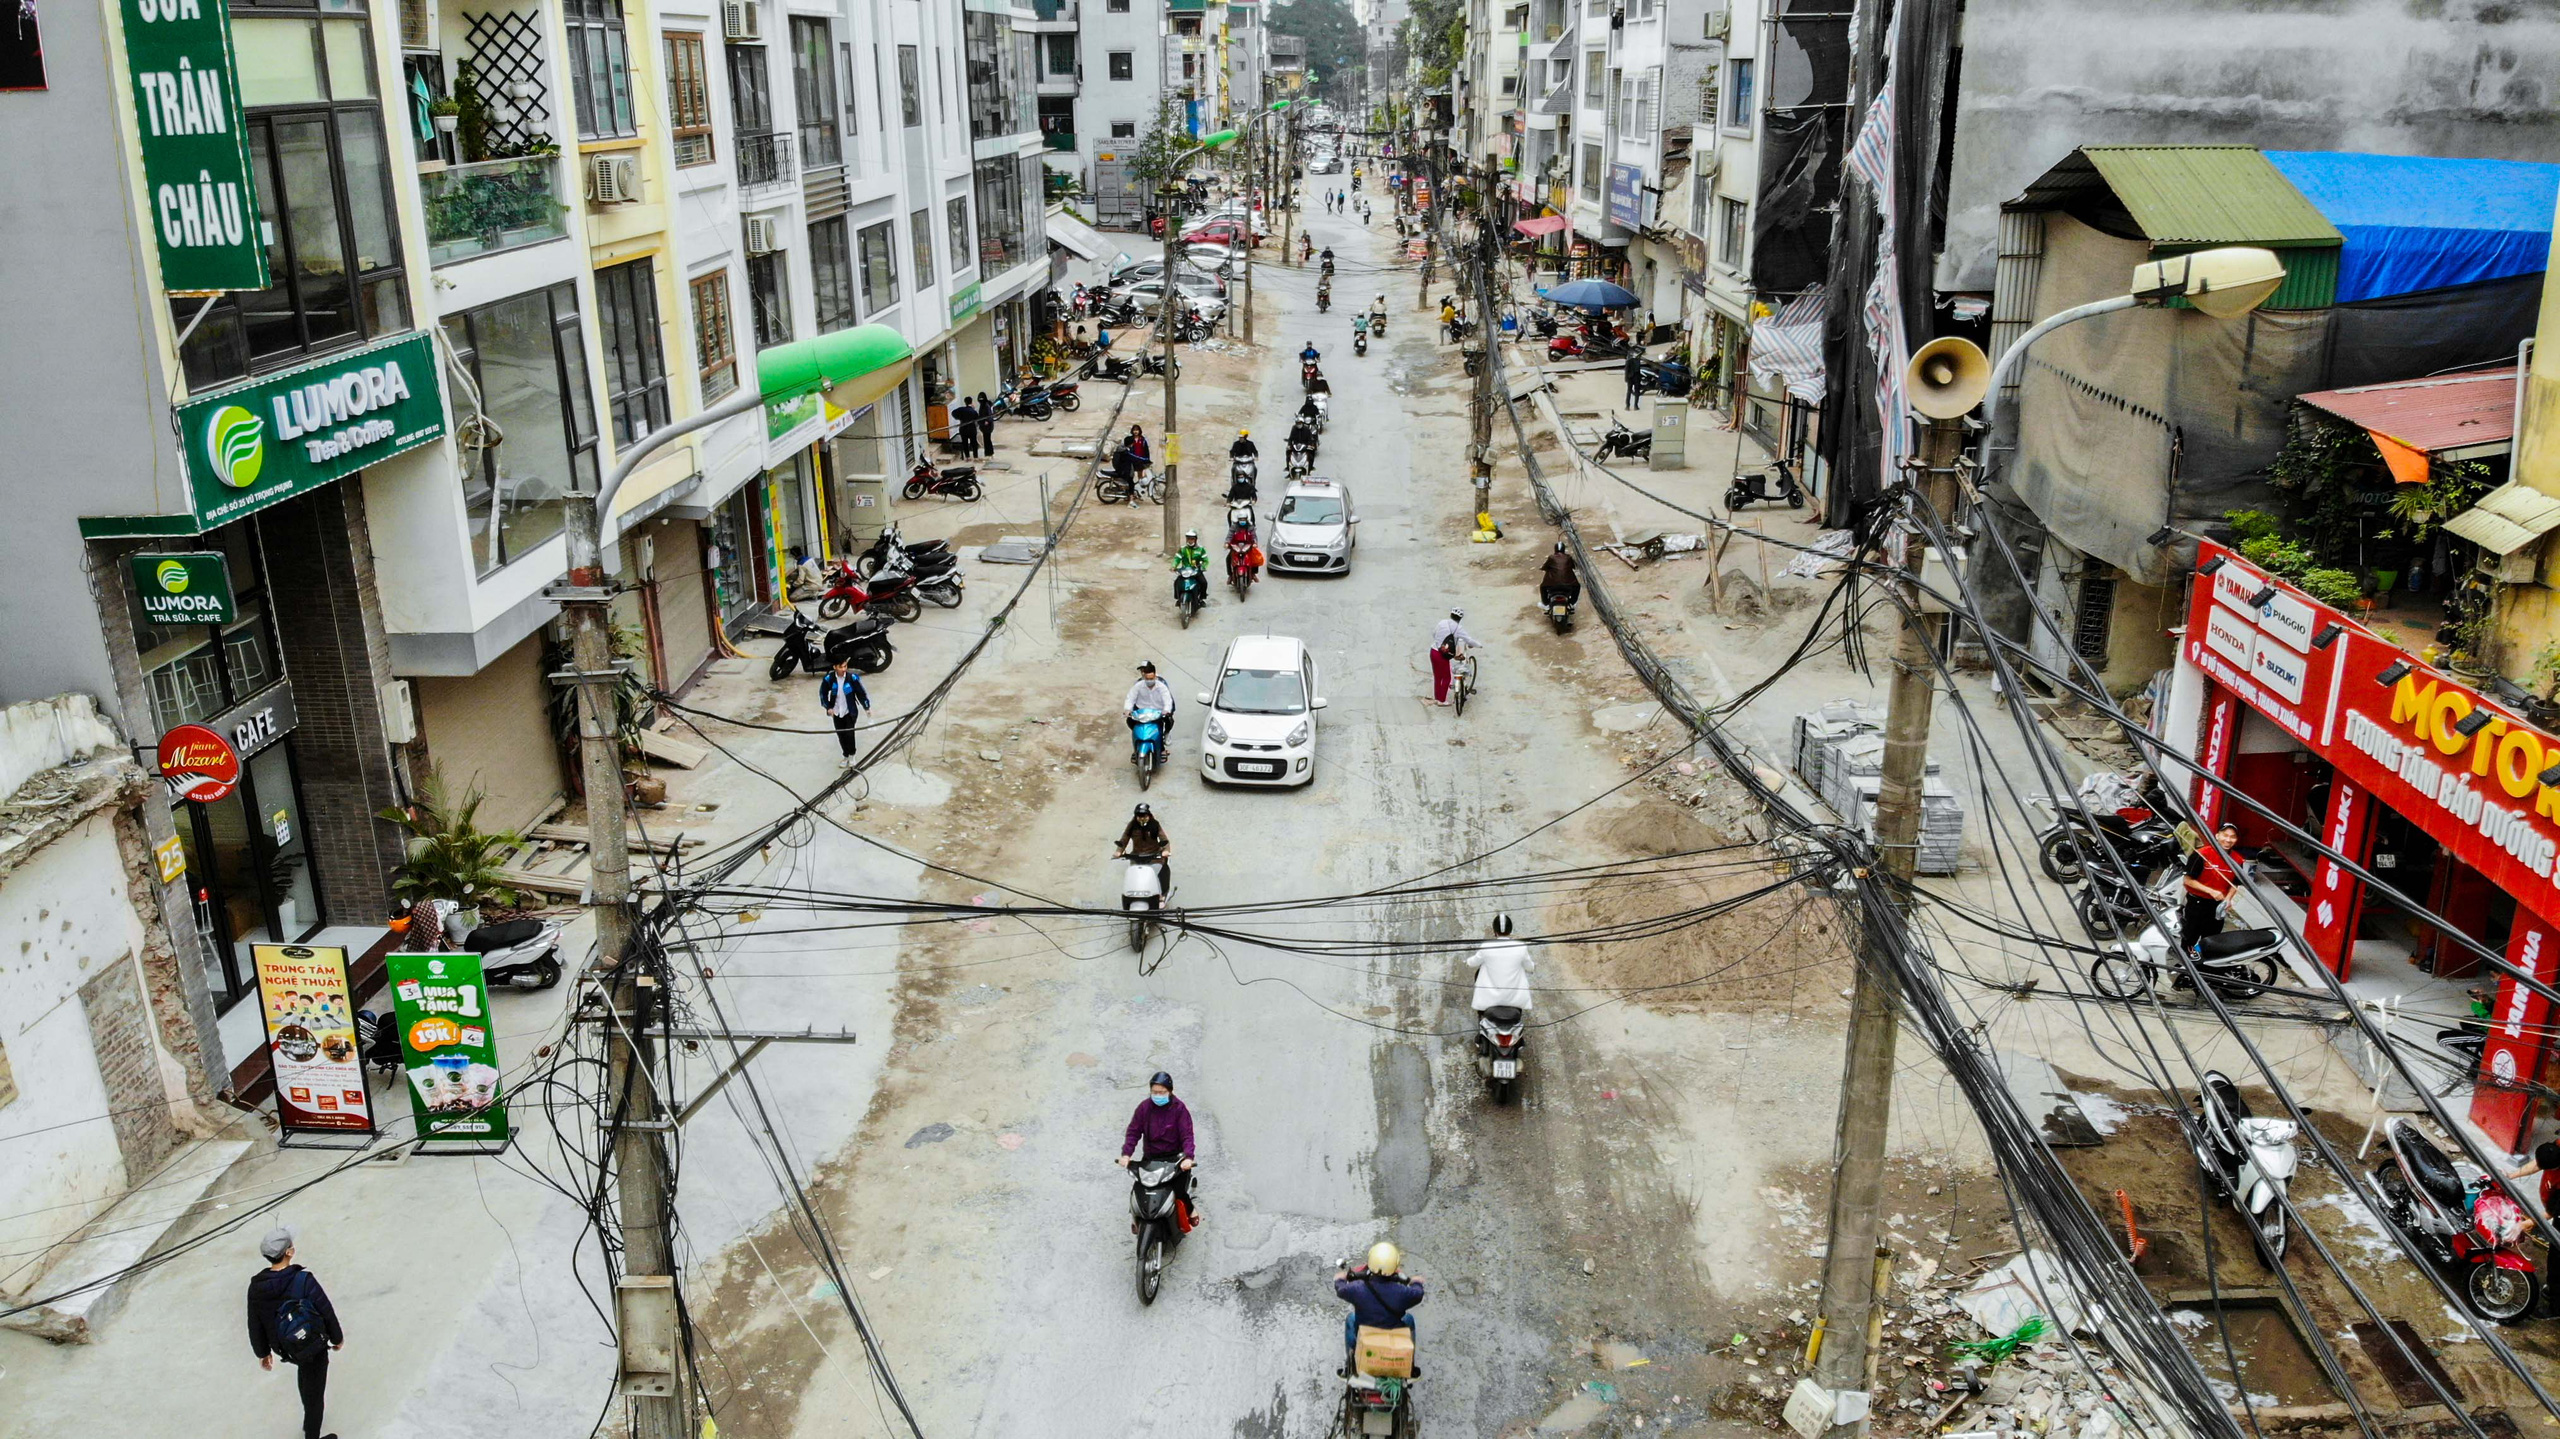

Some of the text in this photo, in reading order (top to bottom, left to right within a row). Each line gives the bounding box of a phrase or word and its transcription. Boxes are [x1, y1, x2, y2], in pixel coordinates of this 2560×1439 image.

[139, 56, 227, 137] TRÂN
[158, 169, 244, 248] CHÂU
[272, 361, 411, 441] LUMORA
[305, 419, 395, 464] Tea & Coffee
[144, 596, 222, 611] LUMORA
[153, 613, 171, 622] TRÀ
[173, 612, 191, 623] SỮA
[198, 614, 222, 622] CAFE
[2273, 610, 2306, 635] PIAGGIO
[2211, 623, 2246, 655] HONDA
[2267, 660, 2297, 686] SUZUKI
[236, 707, 276, 751] CAFE
[162, 746, 228, 769] Mozart
[2344, 709, 2402, 773] TRUNG
[2399, 746, 2442, 799] TÂM
[2437, 772, 2482, 826] BẢO
[160, 844, 183, 877] 25
[264, 964, 335, 975] TRUNG TÂM
[265, 976, 342, 988] NGHỆ THUẬT
[416, 996, 458, 1015] TẶNG
[423, 984, 482, 1018] MUA 1
